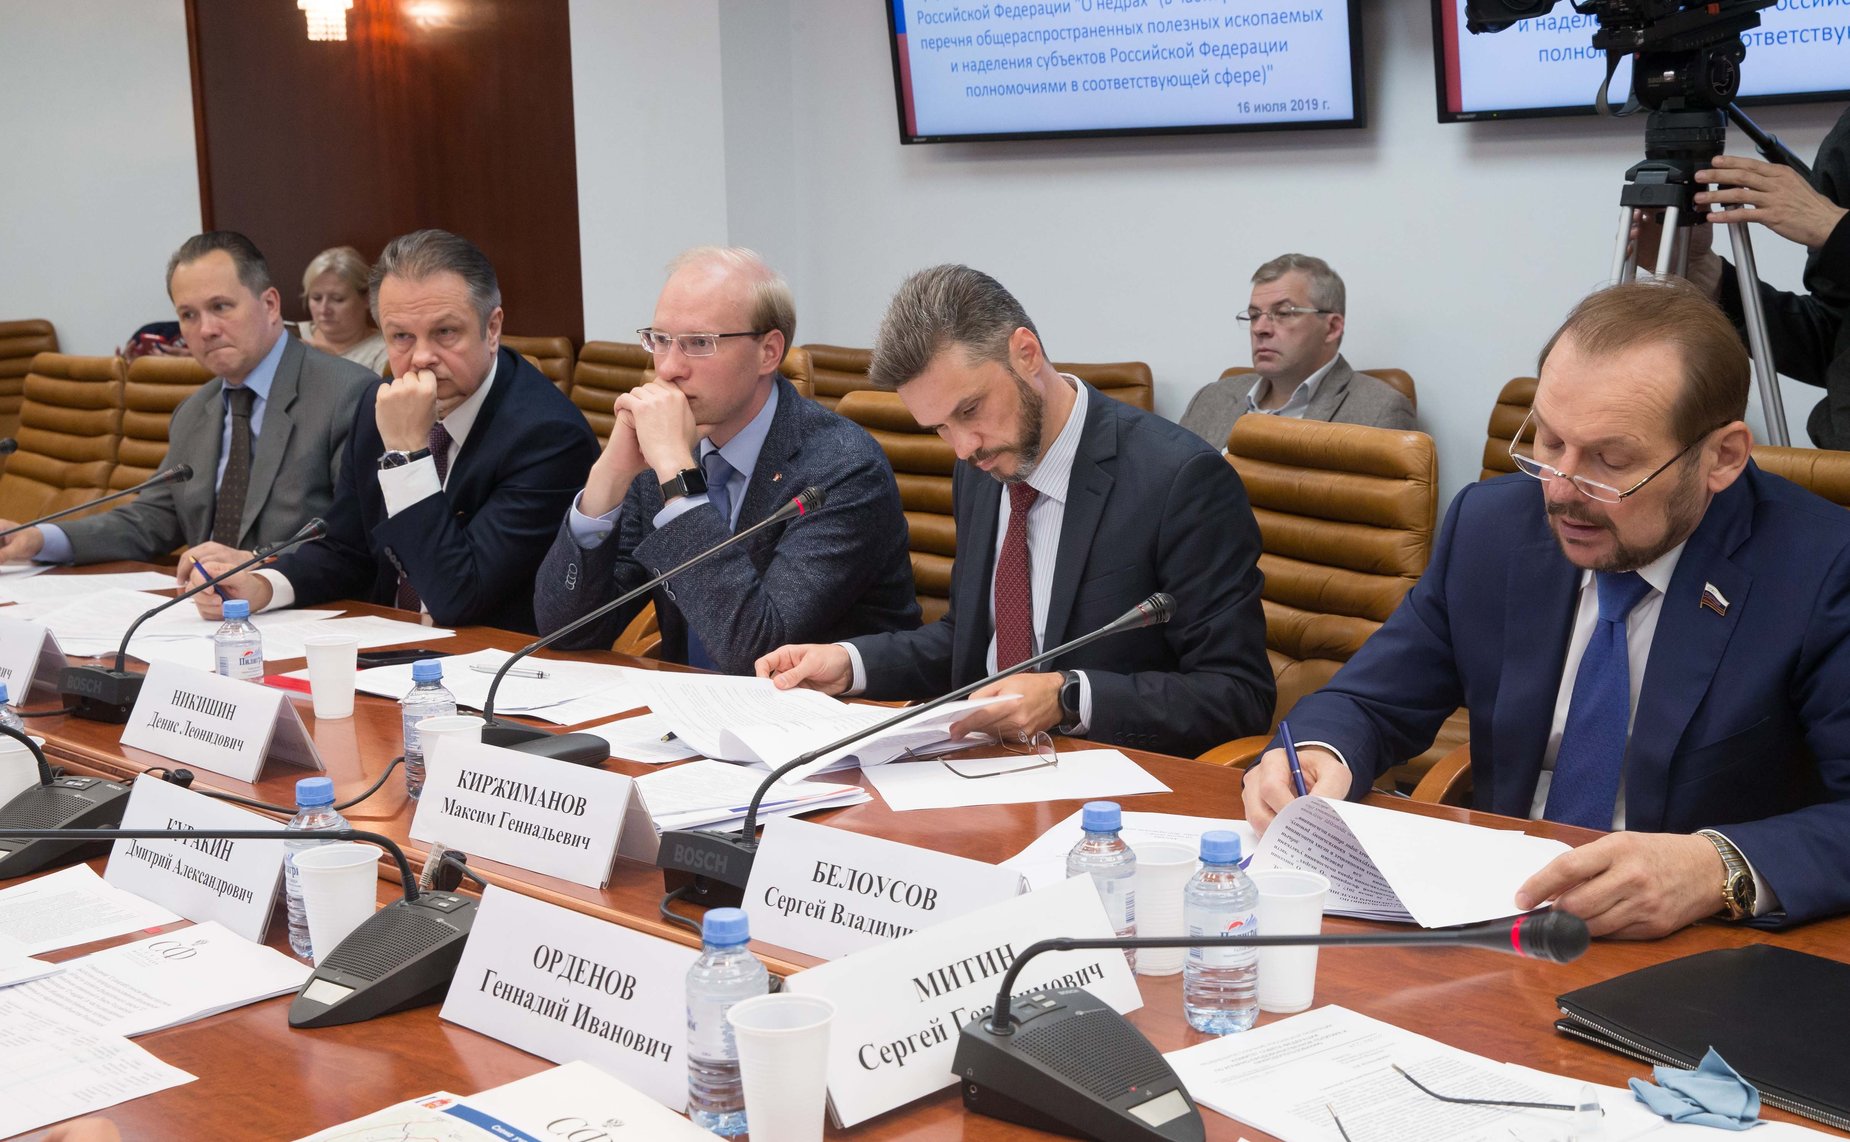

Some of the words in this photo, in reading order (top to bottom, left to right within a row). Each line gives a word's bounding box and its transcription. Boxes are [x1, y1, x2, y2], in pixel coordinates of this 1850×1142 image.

[917, 7, 990, 25] Российской
[993, 1, 1071, 21] Федерации
[921, 34, 973, 52] перечня
[977, 23, 1143, 45] общераспространенных
[1148, 16, 1220, 34] полезных
[1225, 8, 1323, 28] ископаемых
[951, 61, 959, 73] и
[962, 56, 1033, 74] наделения
[1036, 51, 1106, 72] субъектов
[1111, 42, 1195, 63] Российской
[1199, 40, 1288, 60] Федерации
[1740, 26, 1850, 48] ответству
[966, 81, 1067, 98] полномочиями
[1071, 80, 1079, 92] в
[1083, 68, 1209, 92] соответствующей
[1214, 64, 1273, 88] сфере)"
[1237, 101, 1250, 114] 16
[1254, 102, 1287, 114] июля
[1291, 98, 1319, 112] 2019
[1322, 99, 1331, 111] г.
[66, 673, 104, 695] BOSCH
[171, 689, 237, 721] НИКИШИН
[147, 711, 180, 733] Денис
[179, 720, 244, 752] Леонидович
[456, 769, 587, 818] КИРЖИМАНОВ
[440, 796, 496, 827] Максим
[498, 811, 592, 850] Геннадьевич
[125, 839, 173, 870] Дмитрий
[172, 858, 253, 904] Александрович
[673, 843, 729, 875] BOSCH
[764, 886, 826, 917] Сергей
[811, 860, 938, 911] БЕЛОУСОВ
[533, 944, 637, 1002] ОРДЕНОВ
[912, 943, 1016, 1003] МИТИН
[479, 968, 570, 1023] Геннадий
[571, 1001, 672, 1063] Иванович
[858, 1017, 949, 1071] Сергей
